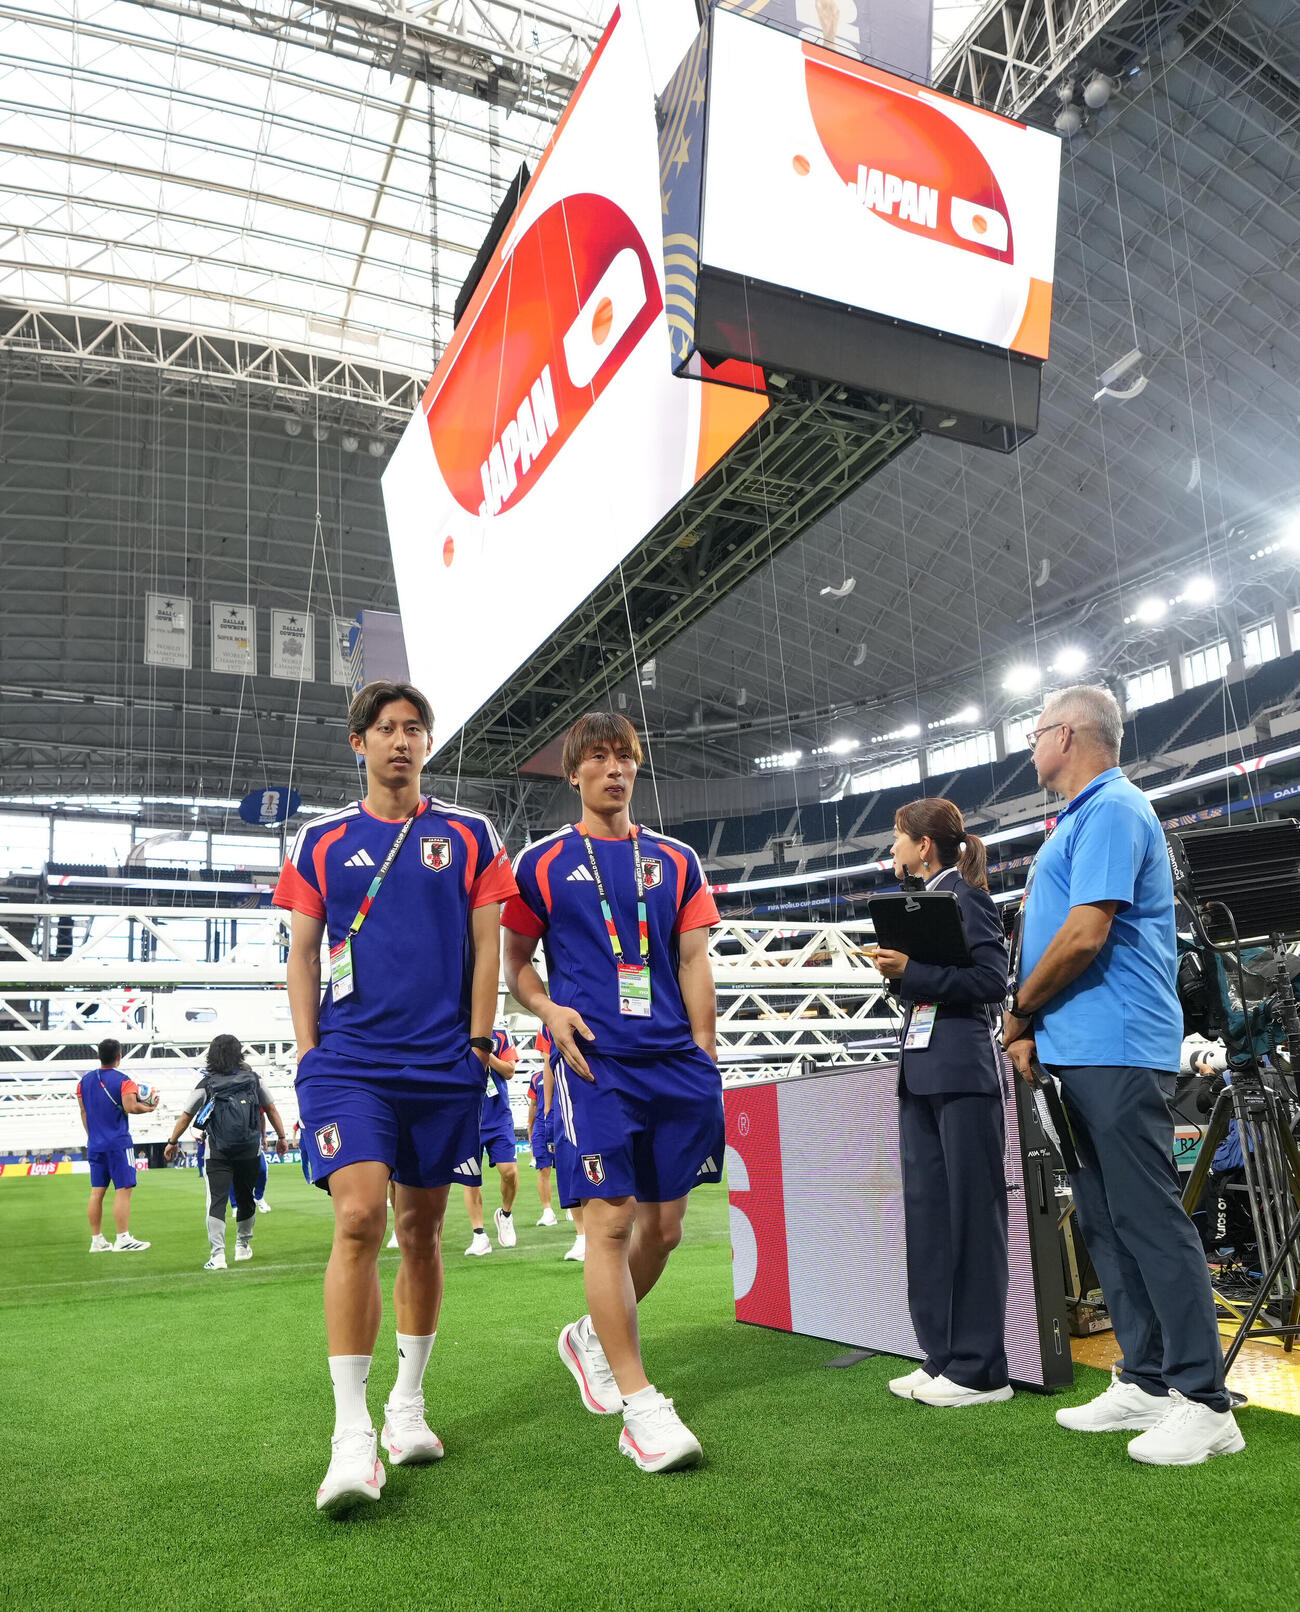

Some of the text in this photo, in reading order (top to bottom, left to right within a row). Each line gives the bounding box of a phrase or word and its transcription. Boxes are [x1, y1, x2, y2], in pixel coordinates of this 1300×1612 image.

[848, 164, 939, 229] JAPAN
[478, 363, 559, 518] JAPAN
[222, 618, 245, 626] DALLAS
[282, 625, 304, 633] DALLAS
[380, 860, 391, 873] FIFA
[388, 843, 399, 861] WORLD
[397, 832, 405, 845] CUP
[588, 854, 597, 866] CUP
[592, 865, 602, 884] WORLD
[780, 902, 800, 910] WORLD
[811, 898, 830, 906] 2026
[30, 1161, 57, 1176] Lay's
